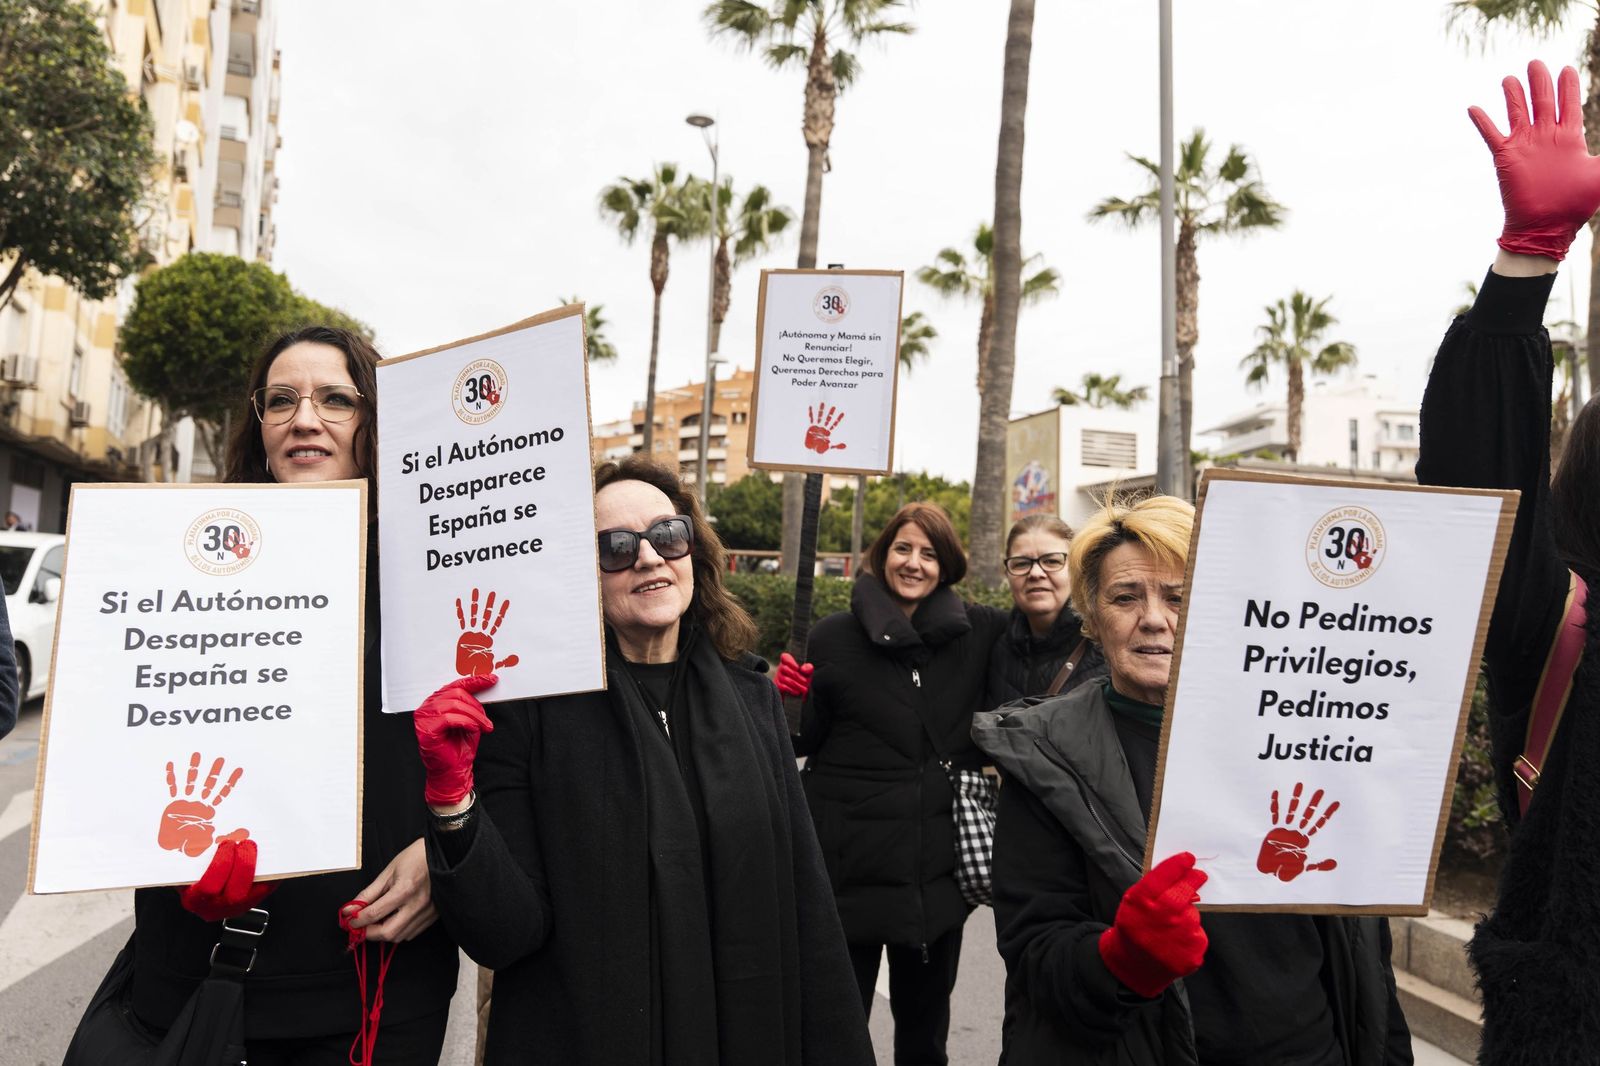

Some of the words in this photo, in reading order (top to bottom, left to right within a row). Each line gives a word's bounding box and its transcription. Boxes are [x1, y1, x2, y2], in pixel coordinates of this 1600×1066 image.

[822, 295, 840, 310] 30
[779, 330, 828, 340] ¡Autónoma
[829, 333, 836, 342] y
[837, 331, 867, 341] Mamá
[868, 332, 882, 341] sin
[804, 342, 853, 353] Renunciar!
[771, 365, 816, 376] Queremos
[818, 367, 859, 378] Derechos
[861, 370, 884, 380] para
[782, 353, 796, 362] No
[797, 354, 843, 364] Queremos
[845, 356, 874, 367] Elegir,
[465, 374, 492, 403] 30
[791, 378, 818, 388] Poder
[819, 379, 859, 389] Avanzar
[475, 401, 482, 410] N
[402, 451, 419, 474] Si
[425, 445, 442, 469] el
[448, 427, 564, 464] Autónomo
[419, 465, 546, 504] Desaparece
[429, 504, 507, 538] España
[513, 503, 537, 520] se
[203, 525, 241, 552] 30
[1325, 526, 1365, 560] 30
[217, 552, 224, 560] N
[427, 538, 543, 571] Desvanece
[1337, 559, 1346, 570] N
[100, 591, 128, 614] Si
[137, 589, 163, 613] el
[171, 589, 329, 612] Autónomo
[1243, 599, 1290, 629] No
[1299, 602, 1433, 635] Pedimos
[124, 627, 303, 655] Desaparece
[1243, 644, 1417, 684] Privilegios,
[135, 663, 247, 694] España
[257, 667, 288, 683] se
[127, 703, 292, 727] Desvanece
[1257, 689, 1390, 720] Pedimos
[1257, 733, 1373, 763] Justicia
